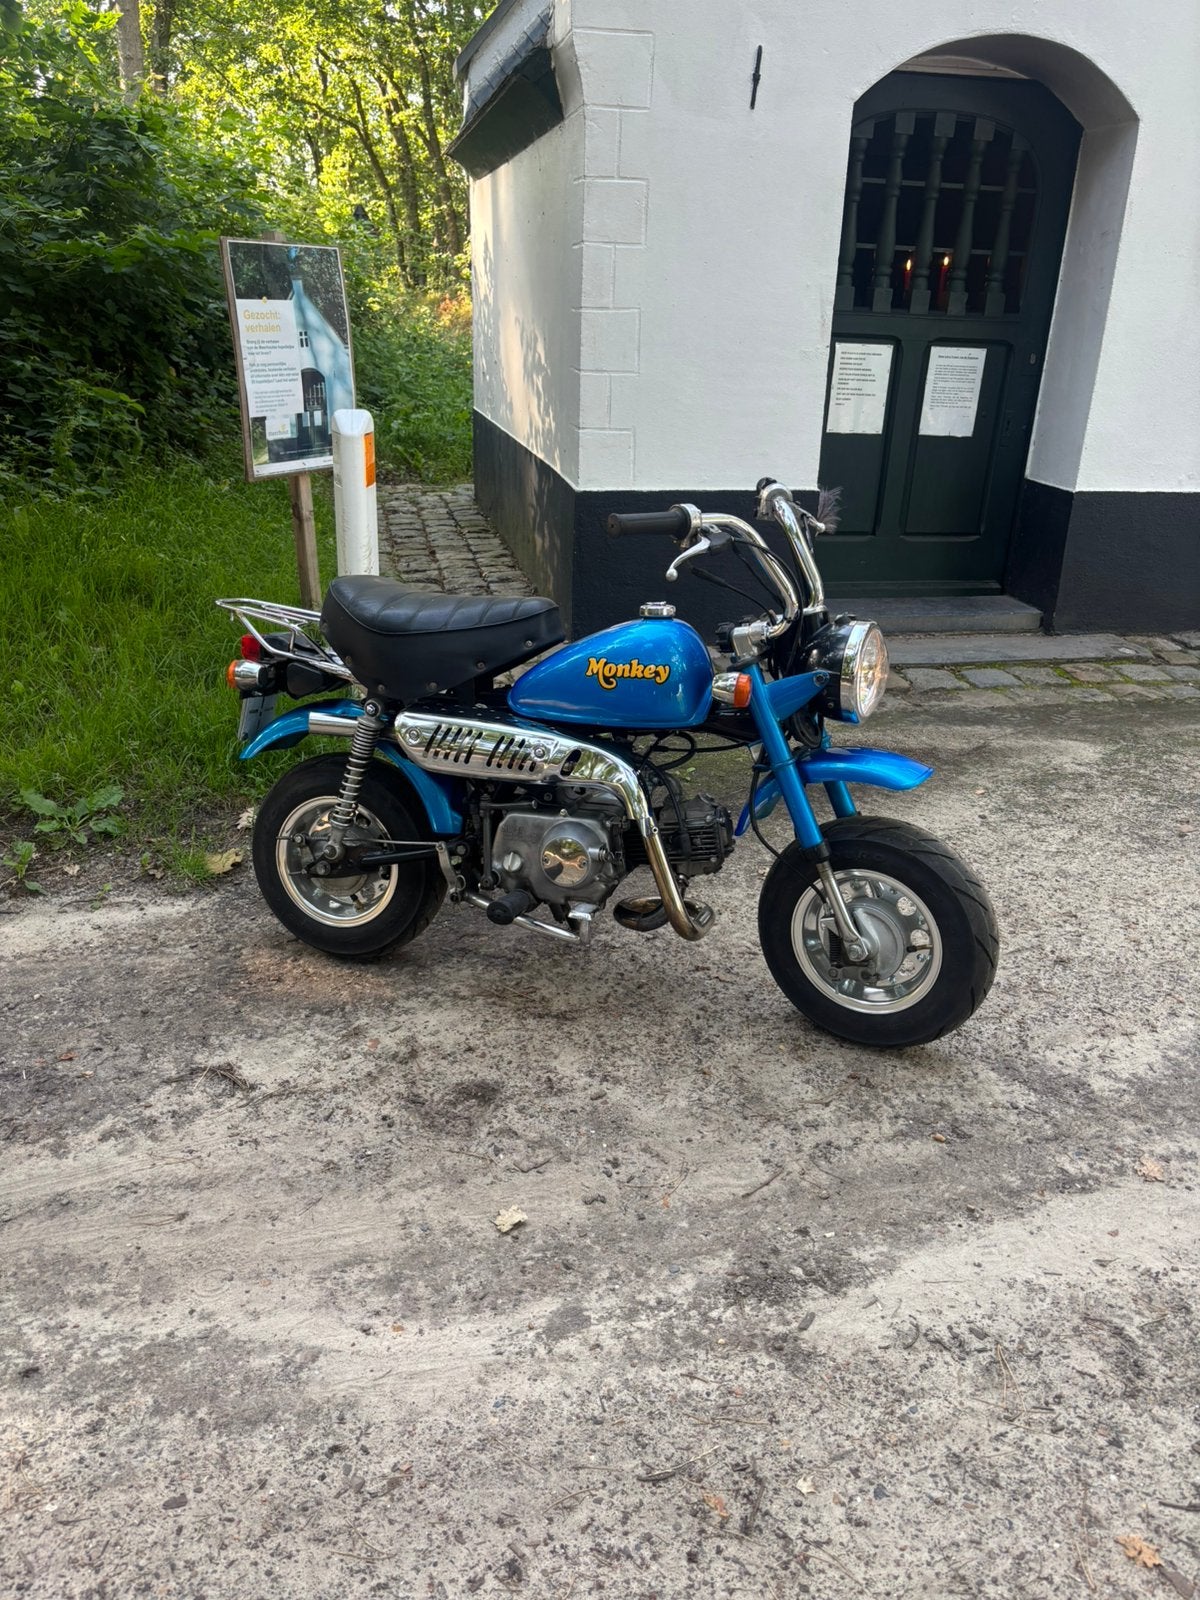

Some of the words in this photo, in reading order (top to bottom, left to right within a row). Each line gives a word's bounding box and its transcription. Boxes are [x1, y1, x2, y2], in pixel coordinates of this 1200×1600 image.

[243, 309, 281, 320] Gezocht:
[245, 323, 281, 333] verhalen
[585, 657, 670, 690] Monkey
